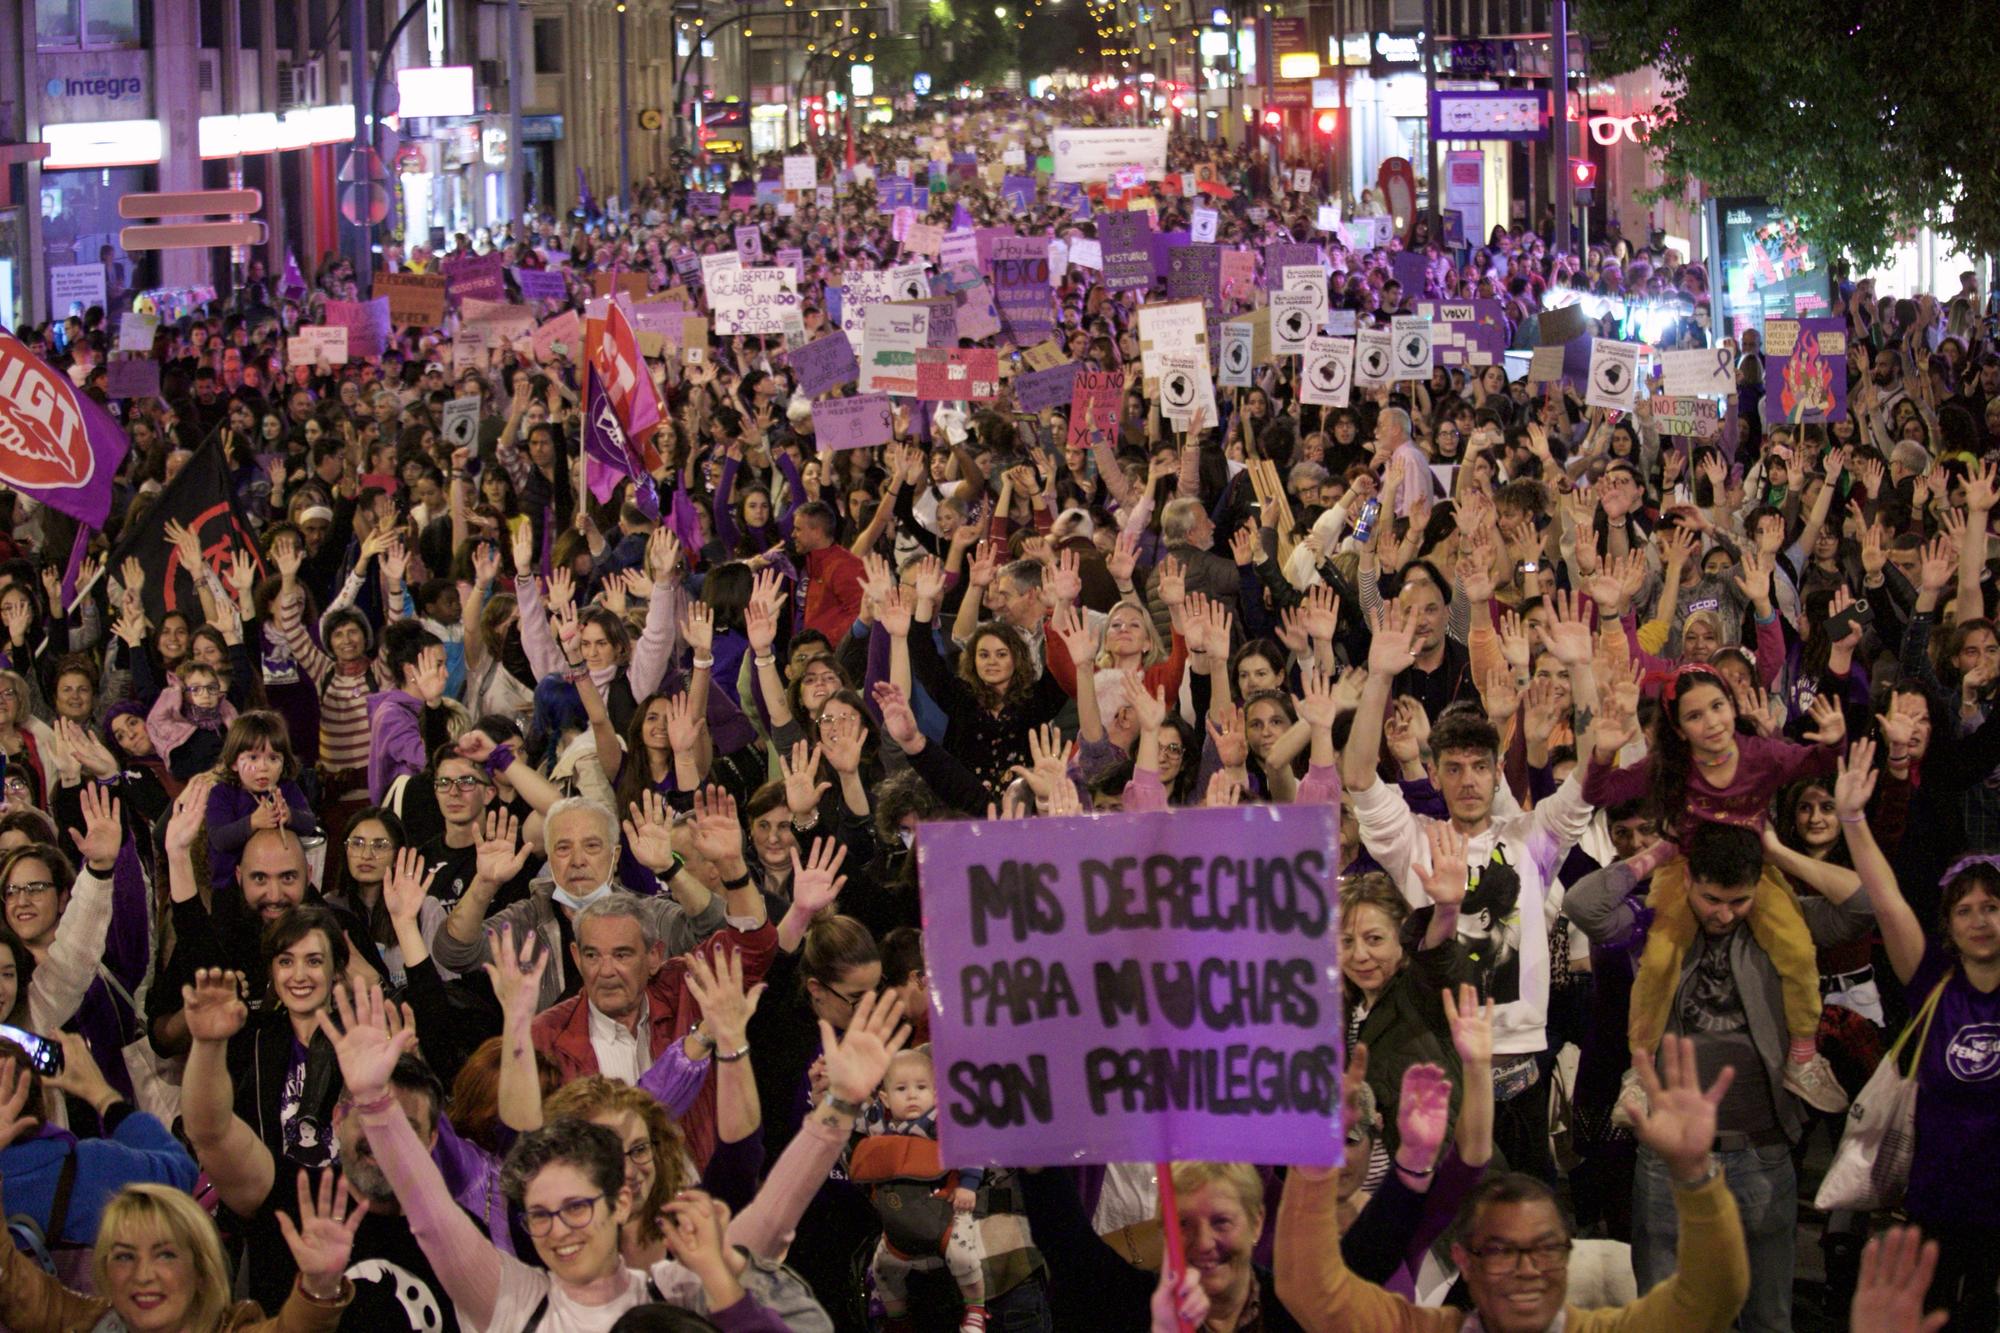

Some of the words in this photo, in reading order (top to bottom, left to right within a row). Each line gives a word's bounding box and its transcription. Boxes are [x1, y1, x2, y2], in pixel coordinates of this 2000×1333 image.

[66, 77, 141, 99] Integra
[733, 270, 784, 282] LIBERTAD
[744, 294, 796, 306] CUANDO
[1076, 373, 1097, 389] NO
[1105, 373, 1124, 389] NO
[1654, 401, 1670, 415] NO
[1673, 400, 1716, 418] ESTAMOS
[1663, 418, 1706, 434] TODAS
[1689, 599, 1718, 612] CCOO
[968, 858, 1065, 946] MIS
[1078, 849, 1330, 940] DERECHOS
[960, 956, 1081, 1027] PARA
[1094, 956, 1320, 1031] MUCHAS
[947, 1053, 1054, 1129] SON
[1085, 1043, 1338, 1118] PRIVILEGIOS
